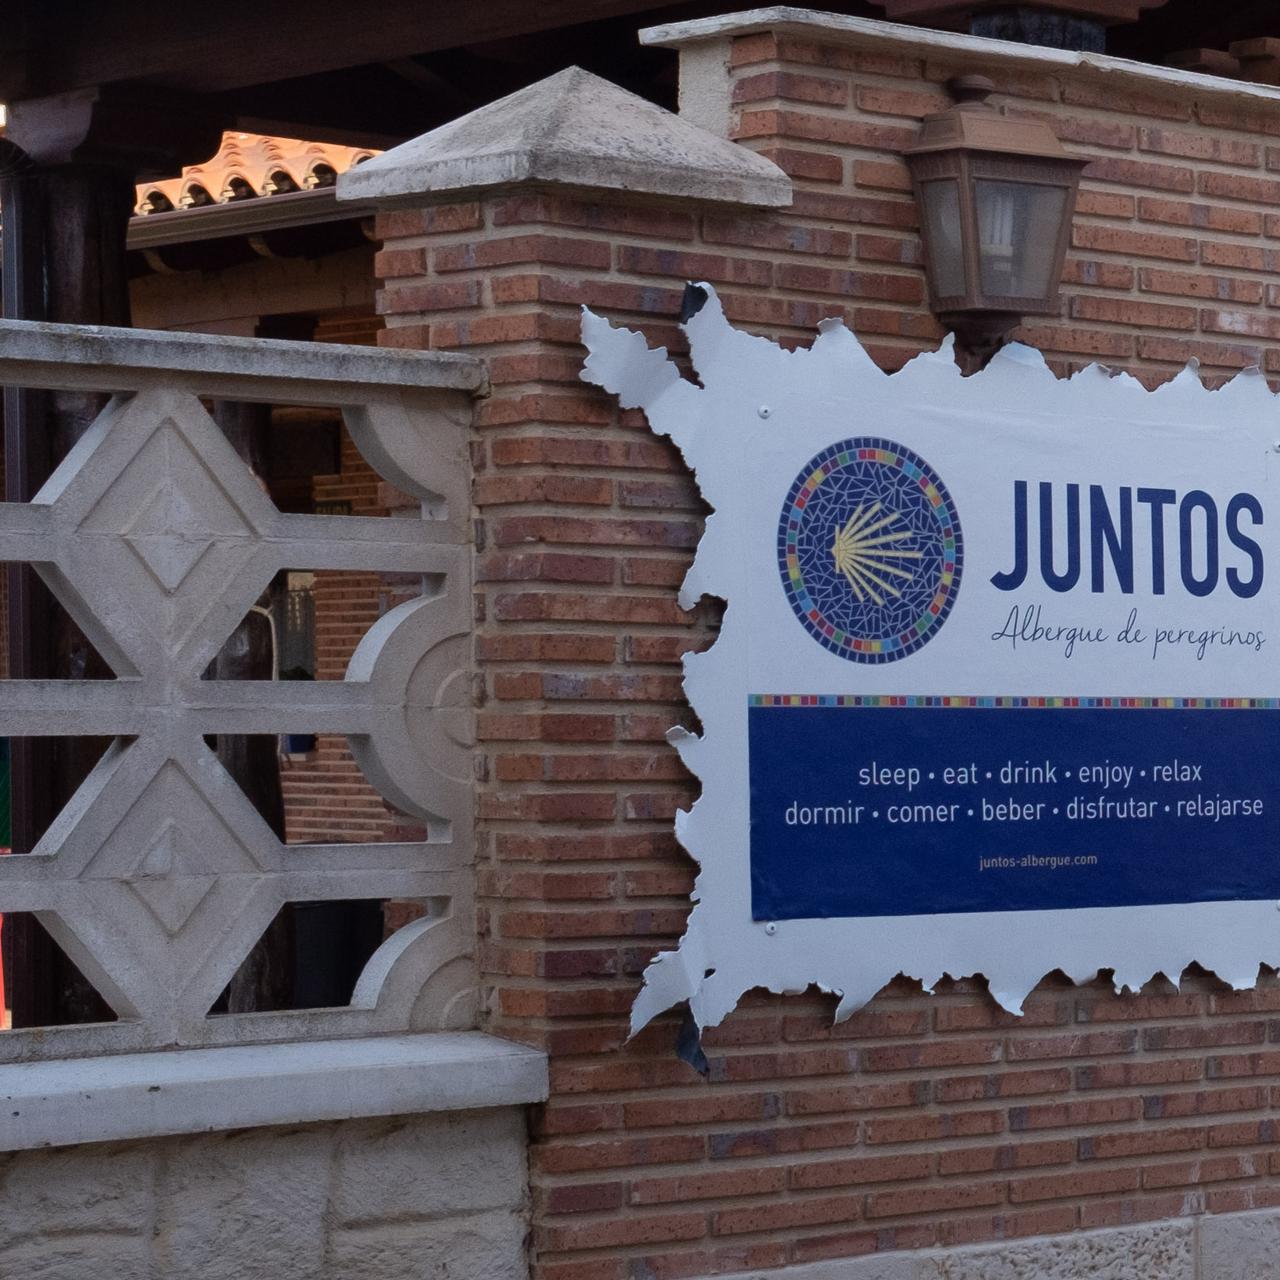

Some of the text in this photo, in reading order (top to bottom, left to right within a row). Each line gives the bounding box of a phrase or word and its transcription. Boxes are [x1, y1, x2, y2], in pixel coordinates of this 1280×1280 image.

[989, 480, 1264, 598] JUNTOS
[990, 604, 1266, 660] Albergue de peregrinos
[858, 759, 1202, 791] sleep eat drink enjoy relax
[785, 794, 1264, 825] dormir comer beber disfrutar relajarse
[979, 854, 1098, 872] juntos-albergue.com
